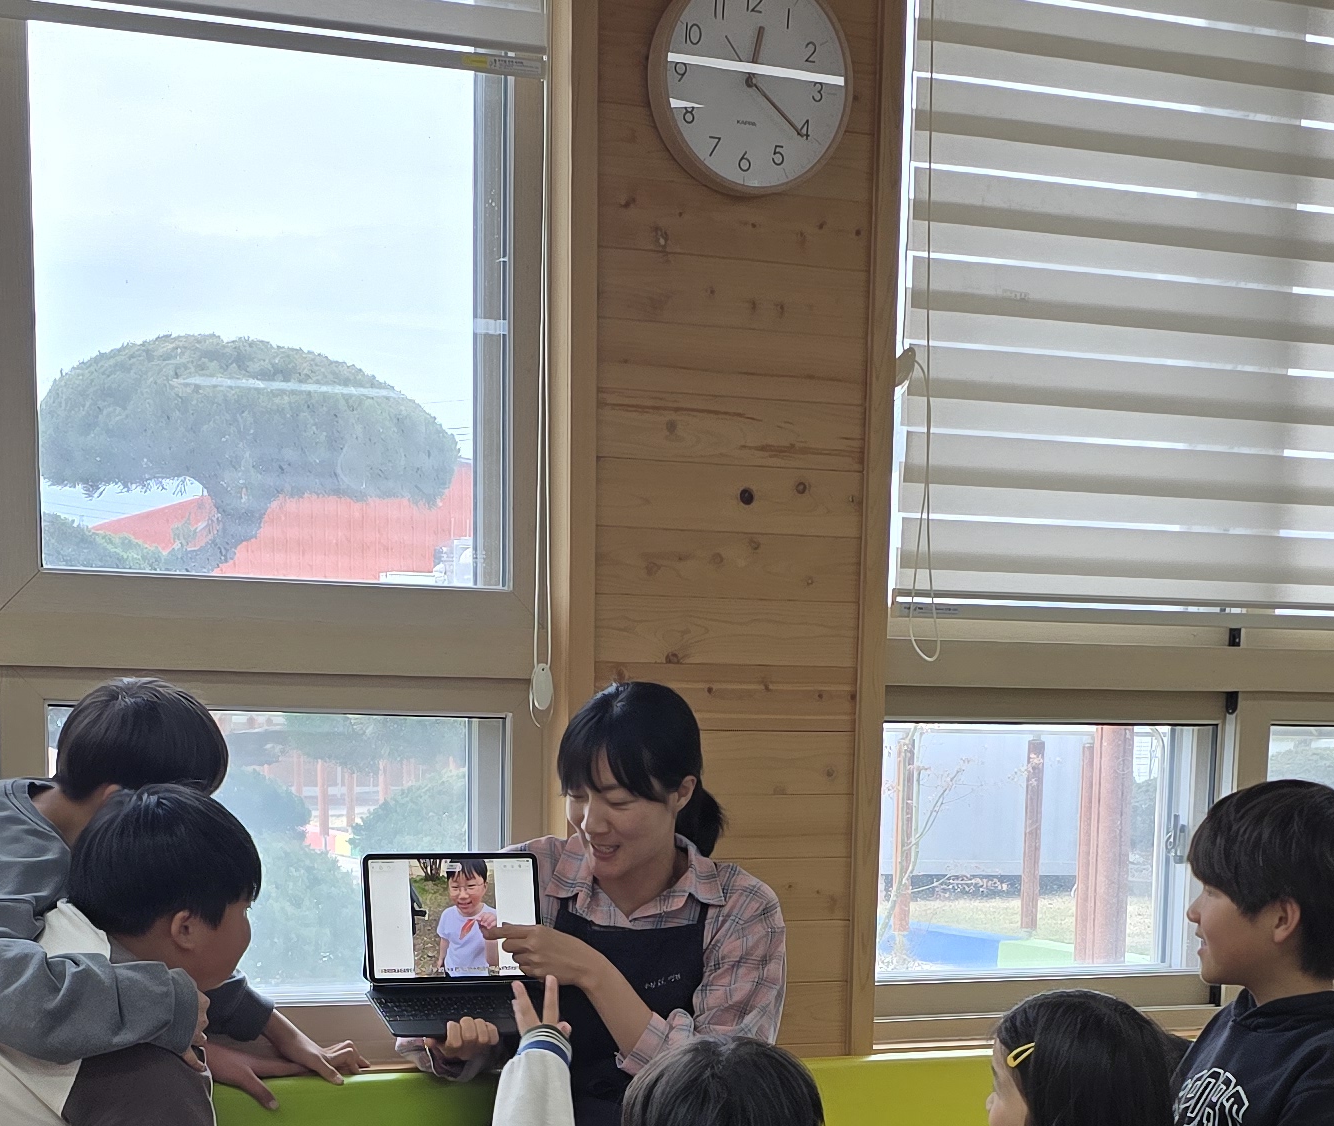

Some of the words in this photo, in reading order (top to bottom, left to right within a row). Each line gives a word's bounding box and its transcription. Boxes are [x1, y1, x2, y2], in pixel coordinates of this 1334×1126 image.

[712, 0, 726, 20] 11
[786, 8, 791, 30] 1
[684, 21, 703, 46] 10
[804, 40, 817, 64] 2
[673, 61, 688, 82] 9
[811, 81, 824, 103] 3
[682, 106, 695, 124] 8
[797, 118, 811, 141] 4
[708, 136, 722, 157] 7
[771, 144, 785, 166] 5
[737, 150, 752, 172] 6
